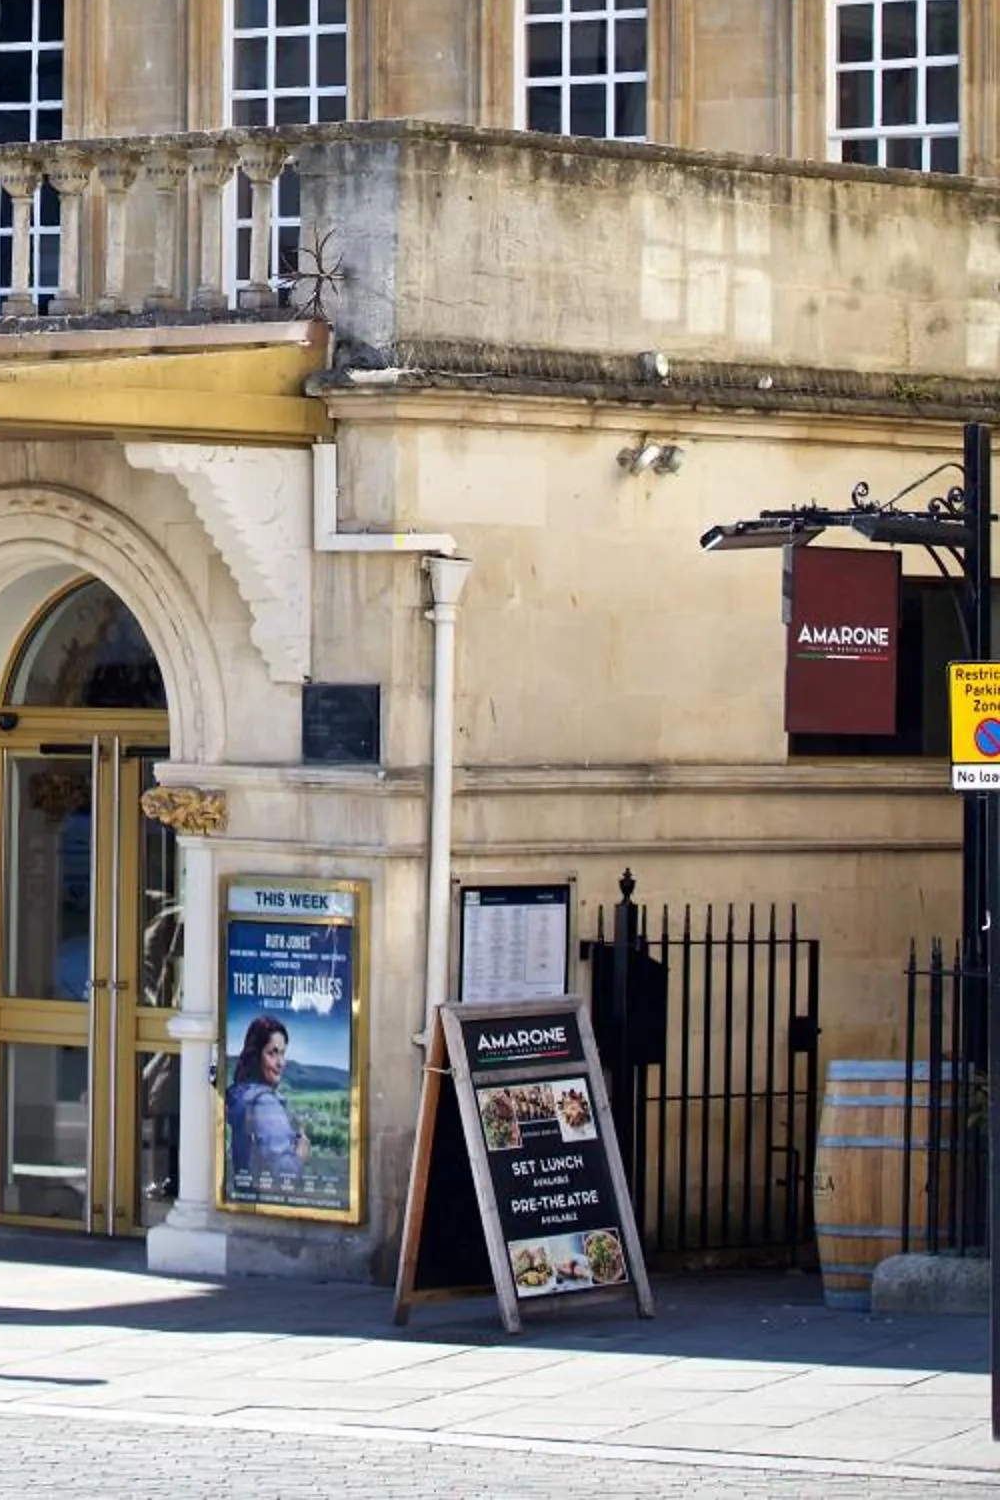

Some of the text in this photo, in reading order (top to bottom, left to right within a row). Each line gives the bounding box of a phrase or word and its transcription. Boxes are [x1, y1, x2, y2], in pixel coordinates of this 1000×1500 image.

[797, 623, 889, 647] AMARONE
[958, 771, 976, 783] No
[255, 891, 329, 909] THIS WEEK
[265, 933, 311, 950] RUTH JONES
[233, 972, 343, 1000] THE NIGHTINGALES
[477, 1026, 567, 1051] AMARONE
[511, 1155, 584, 1176] SET LUNCH
[511, 1189, 599, 1214] PRE-THEATRE
